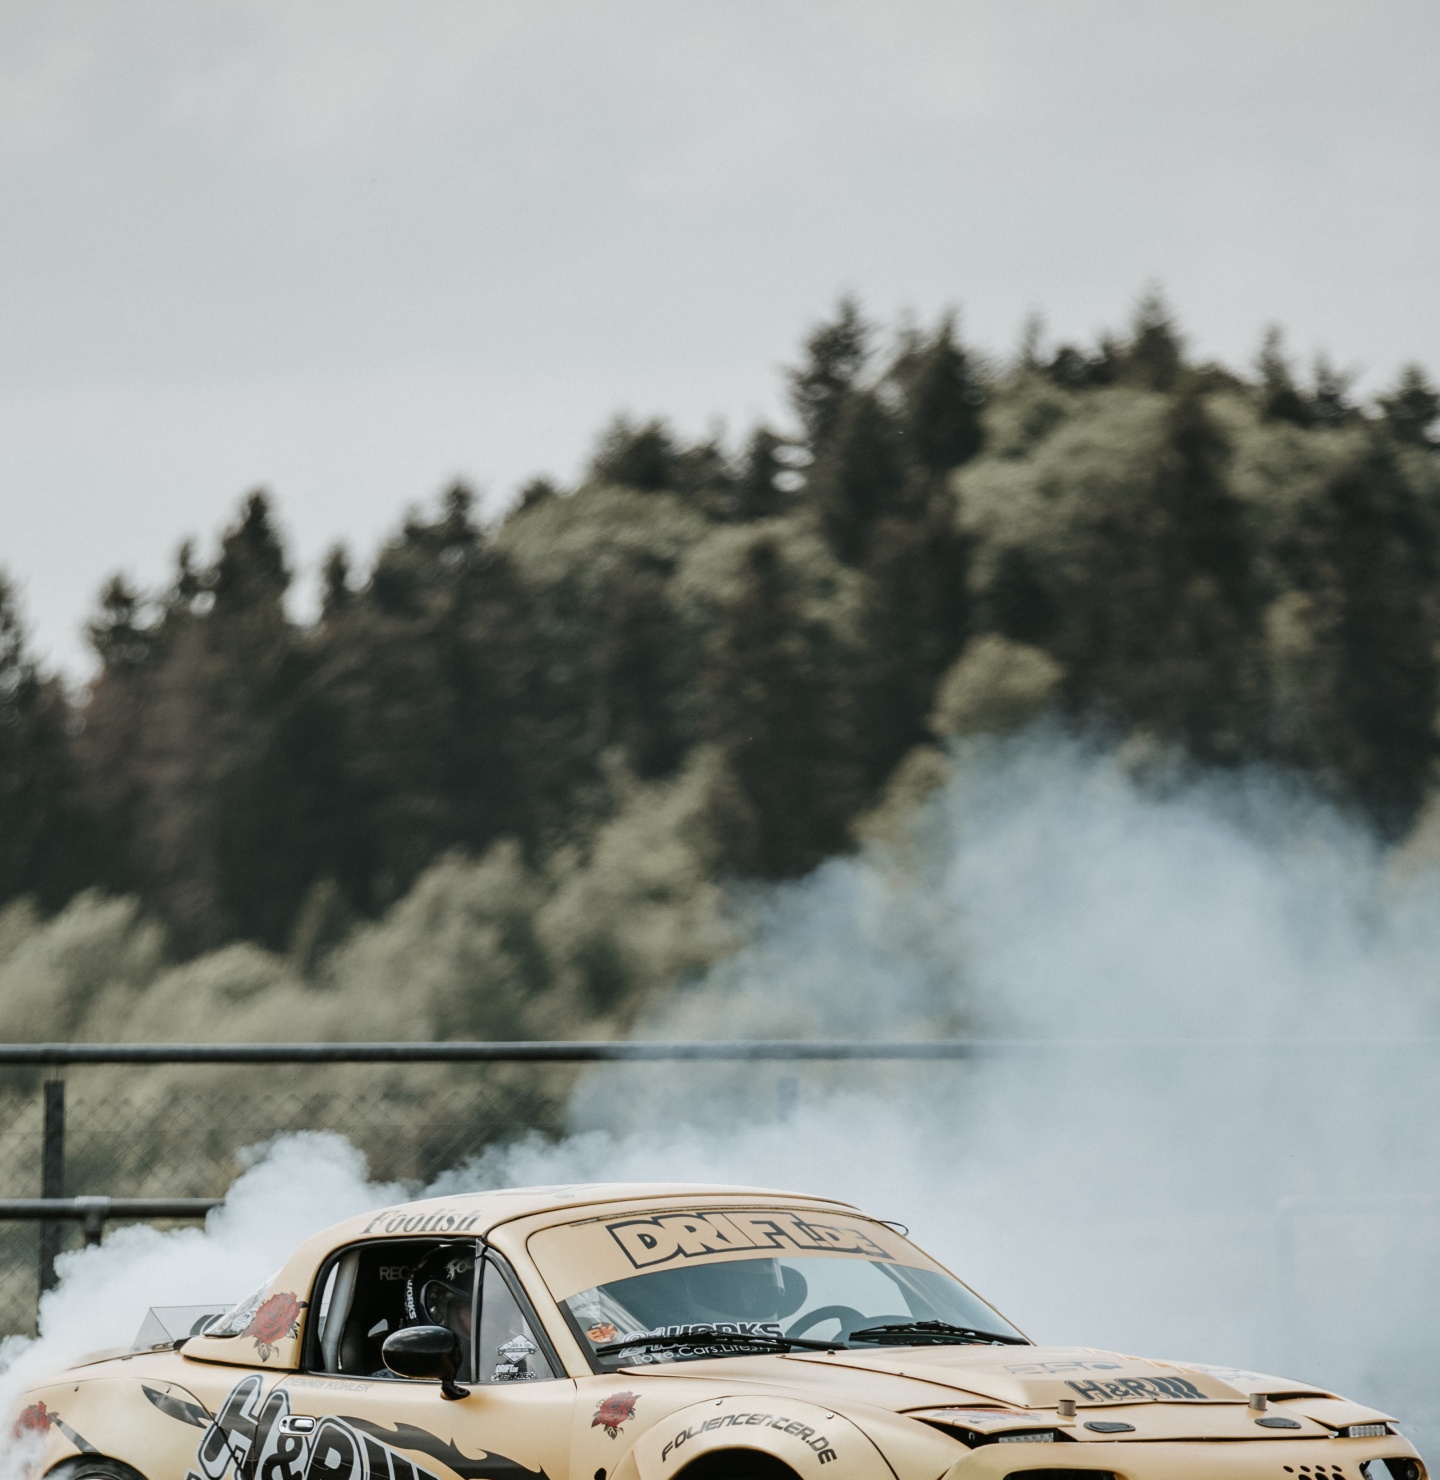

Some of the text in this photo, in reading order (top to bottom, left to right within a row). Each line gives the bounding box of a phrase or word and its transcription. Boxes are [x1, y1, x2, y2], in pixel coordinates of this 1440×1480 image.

[360, 1208, 482, 1234] Foolish
[283, 1376, 325, 1389] DENNIS
[661, 1413, 838, 1465] FOLIENCENTER.DE
